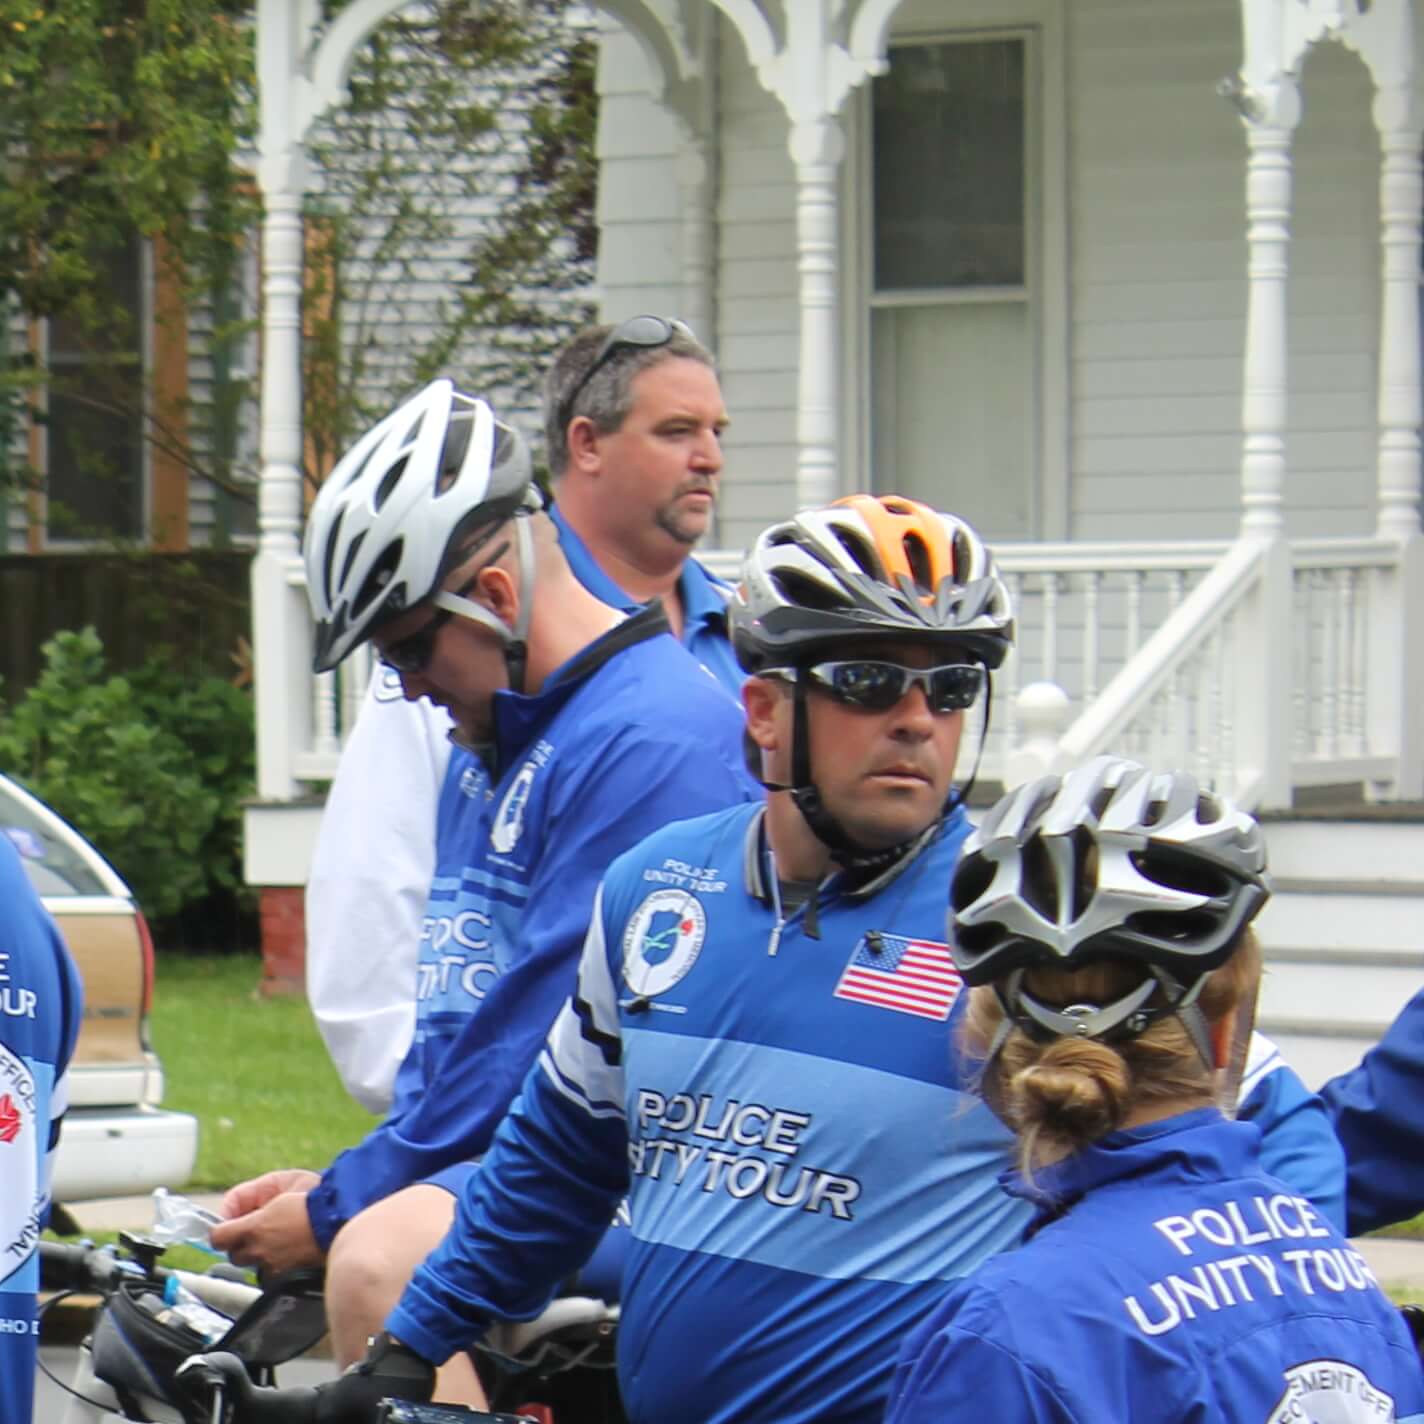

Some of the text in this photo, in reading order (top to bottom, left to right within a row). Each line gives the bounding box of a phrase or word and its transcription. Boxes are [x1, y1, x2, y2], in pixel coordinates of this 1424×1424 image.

[642, 868, 729, 894] UNITY TOUR
[662, 857, 720, 881] POLICE
[636, 1089, 812, 1156] POLICE
[632, 1138, 704, 1186] ITY
[702, 1151, 864, 1223] TOUR
[1153, 1195, 1332, 1256] POLICE
[1124, 1253, 1284, 1337] UNITY
